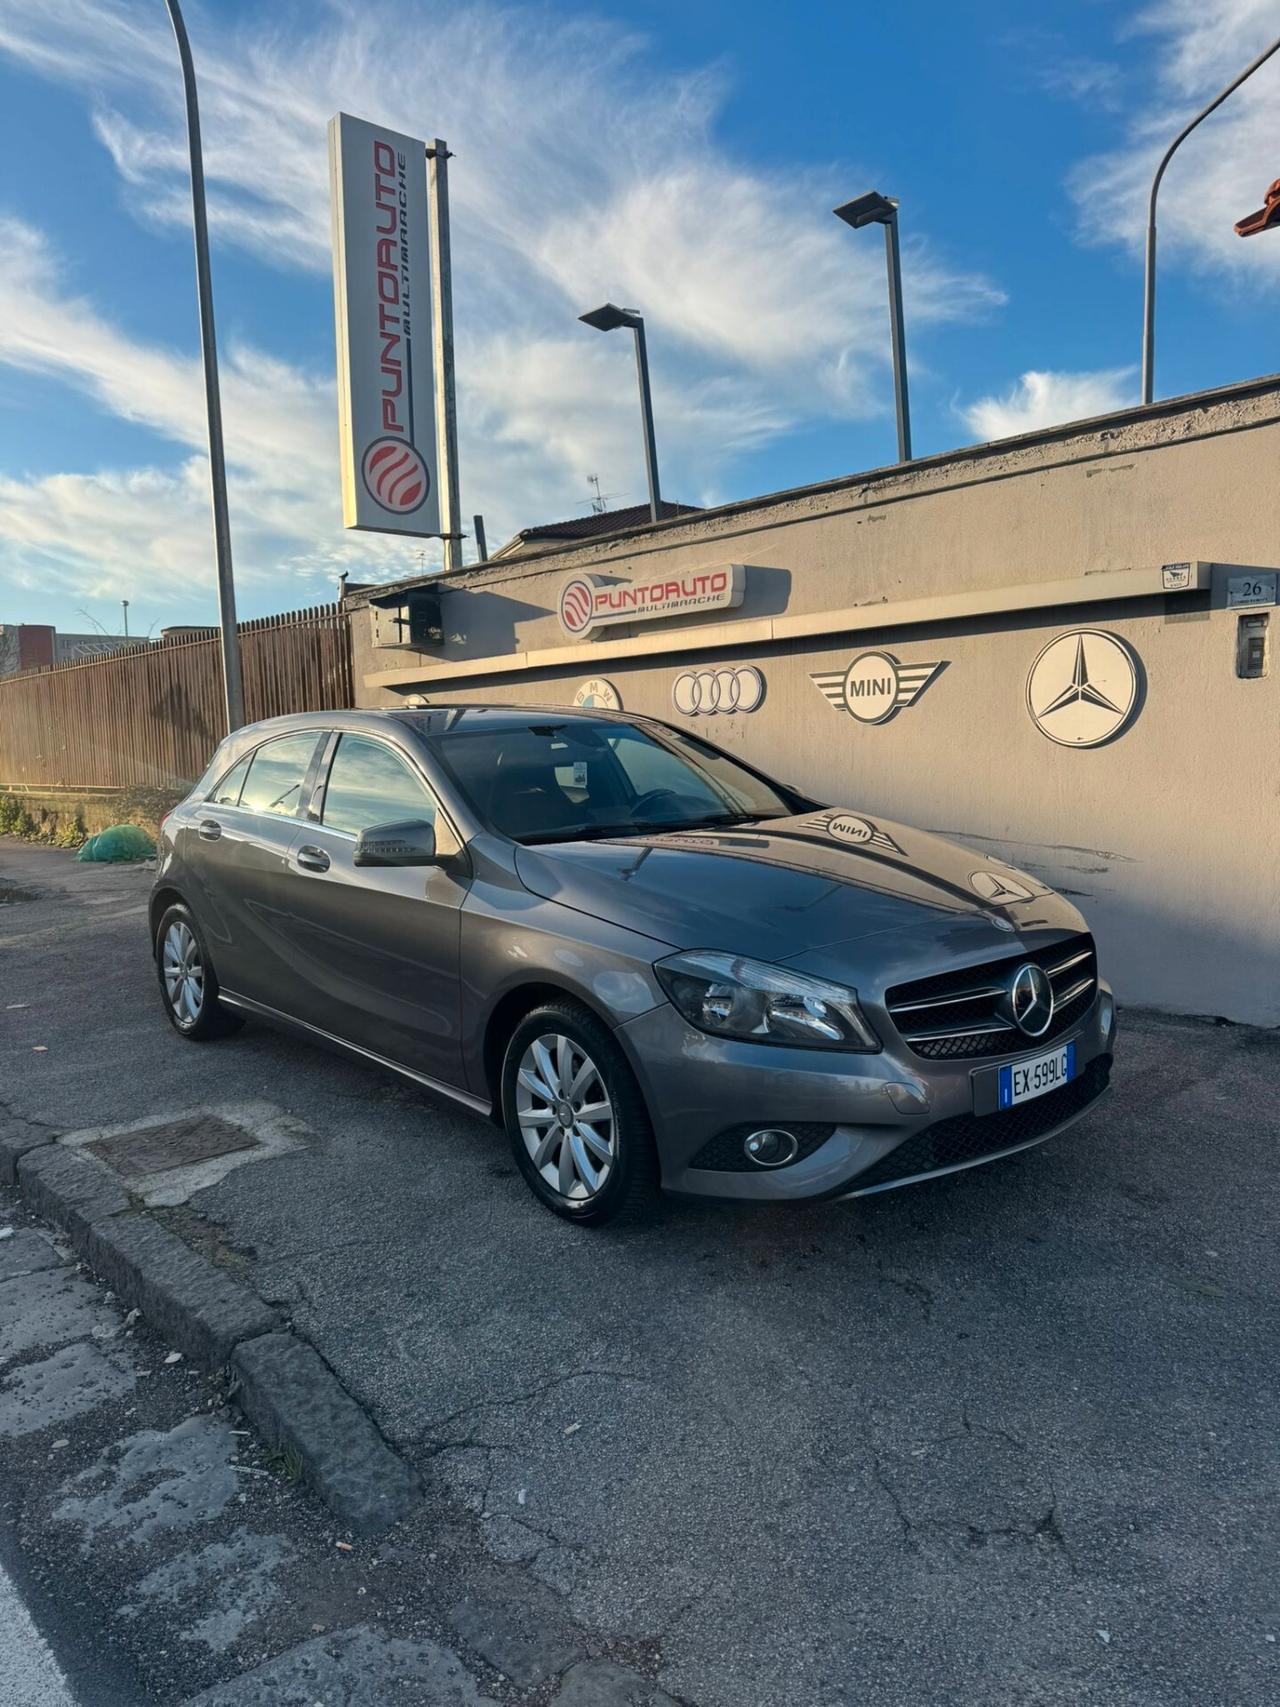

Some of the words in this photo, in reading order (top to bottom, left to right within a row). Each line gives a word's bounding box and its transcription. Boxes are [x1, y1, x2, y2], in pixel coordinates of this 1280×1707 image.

[397, 151, 411, 337] MULTIMARCHE
[374, 141, 404, 433] PUNTOAUTO
[595, 573, 727, 611] PUNTOAUTO
[1243, 582, 1262, 596] 26
[637, 594, 726, 612] MULTIMARCHE
[576, 681, 613, 705] BMW
[849, 677, 891, 697] MINI
[1014, 1068, 1030, 1096] EX
